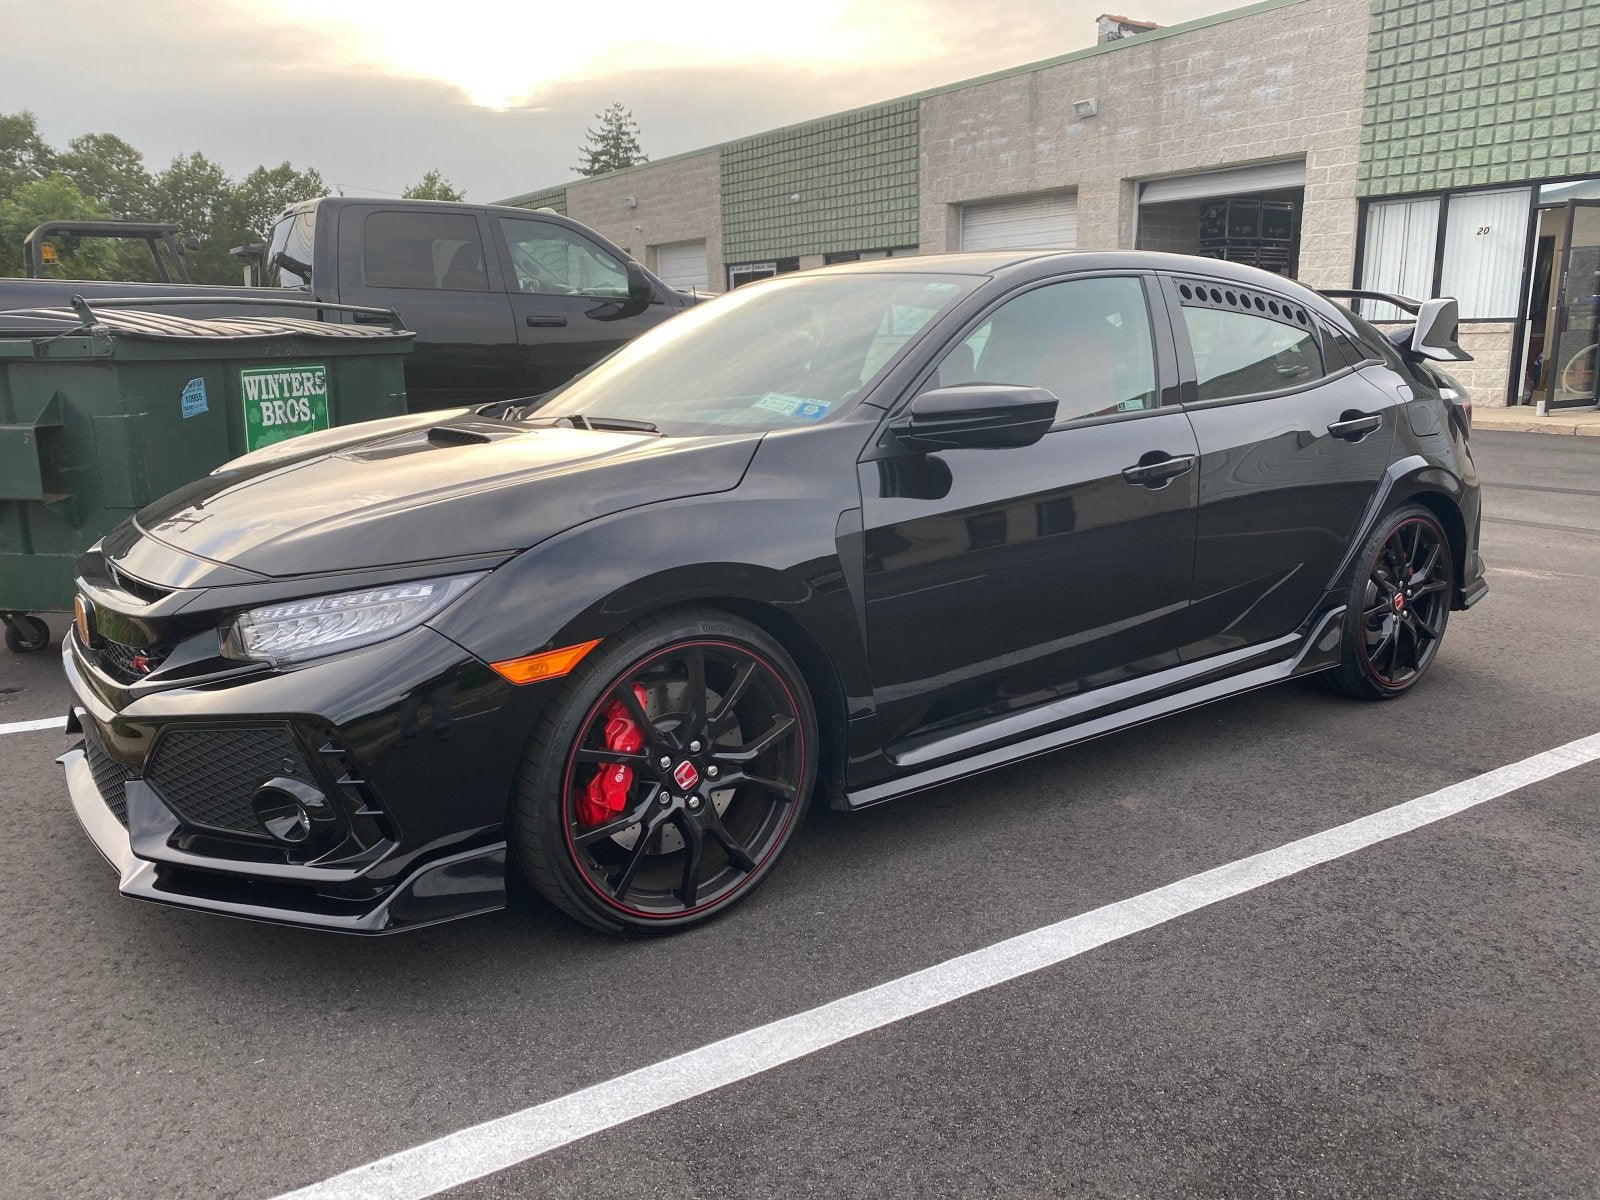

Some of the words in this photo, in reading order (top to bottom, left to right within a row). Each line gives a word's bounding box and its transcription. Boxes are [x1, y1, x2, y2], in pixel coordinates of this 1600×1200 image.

[1476, 226, 1490, 236] 20
[243, 371, 326, 400] WINTERS
[185, 392, 203, 404] 10955
[260, 398, 316, 427] BROS.
